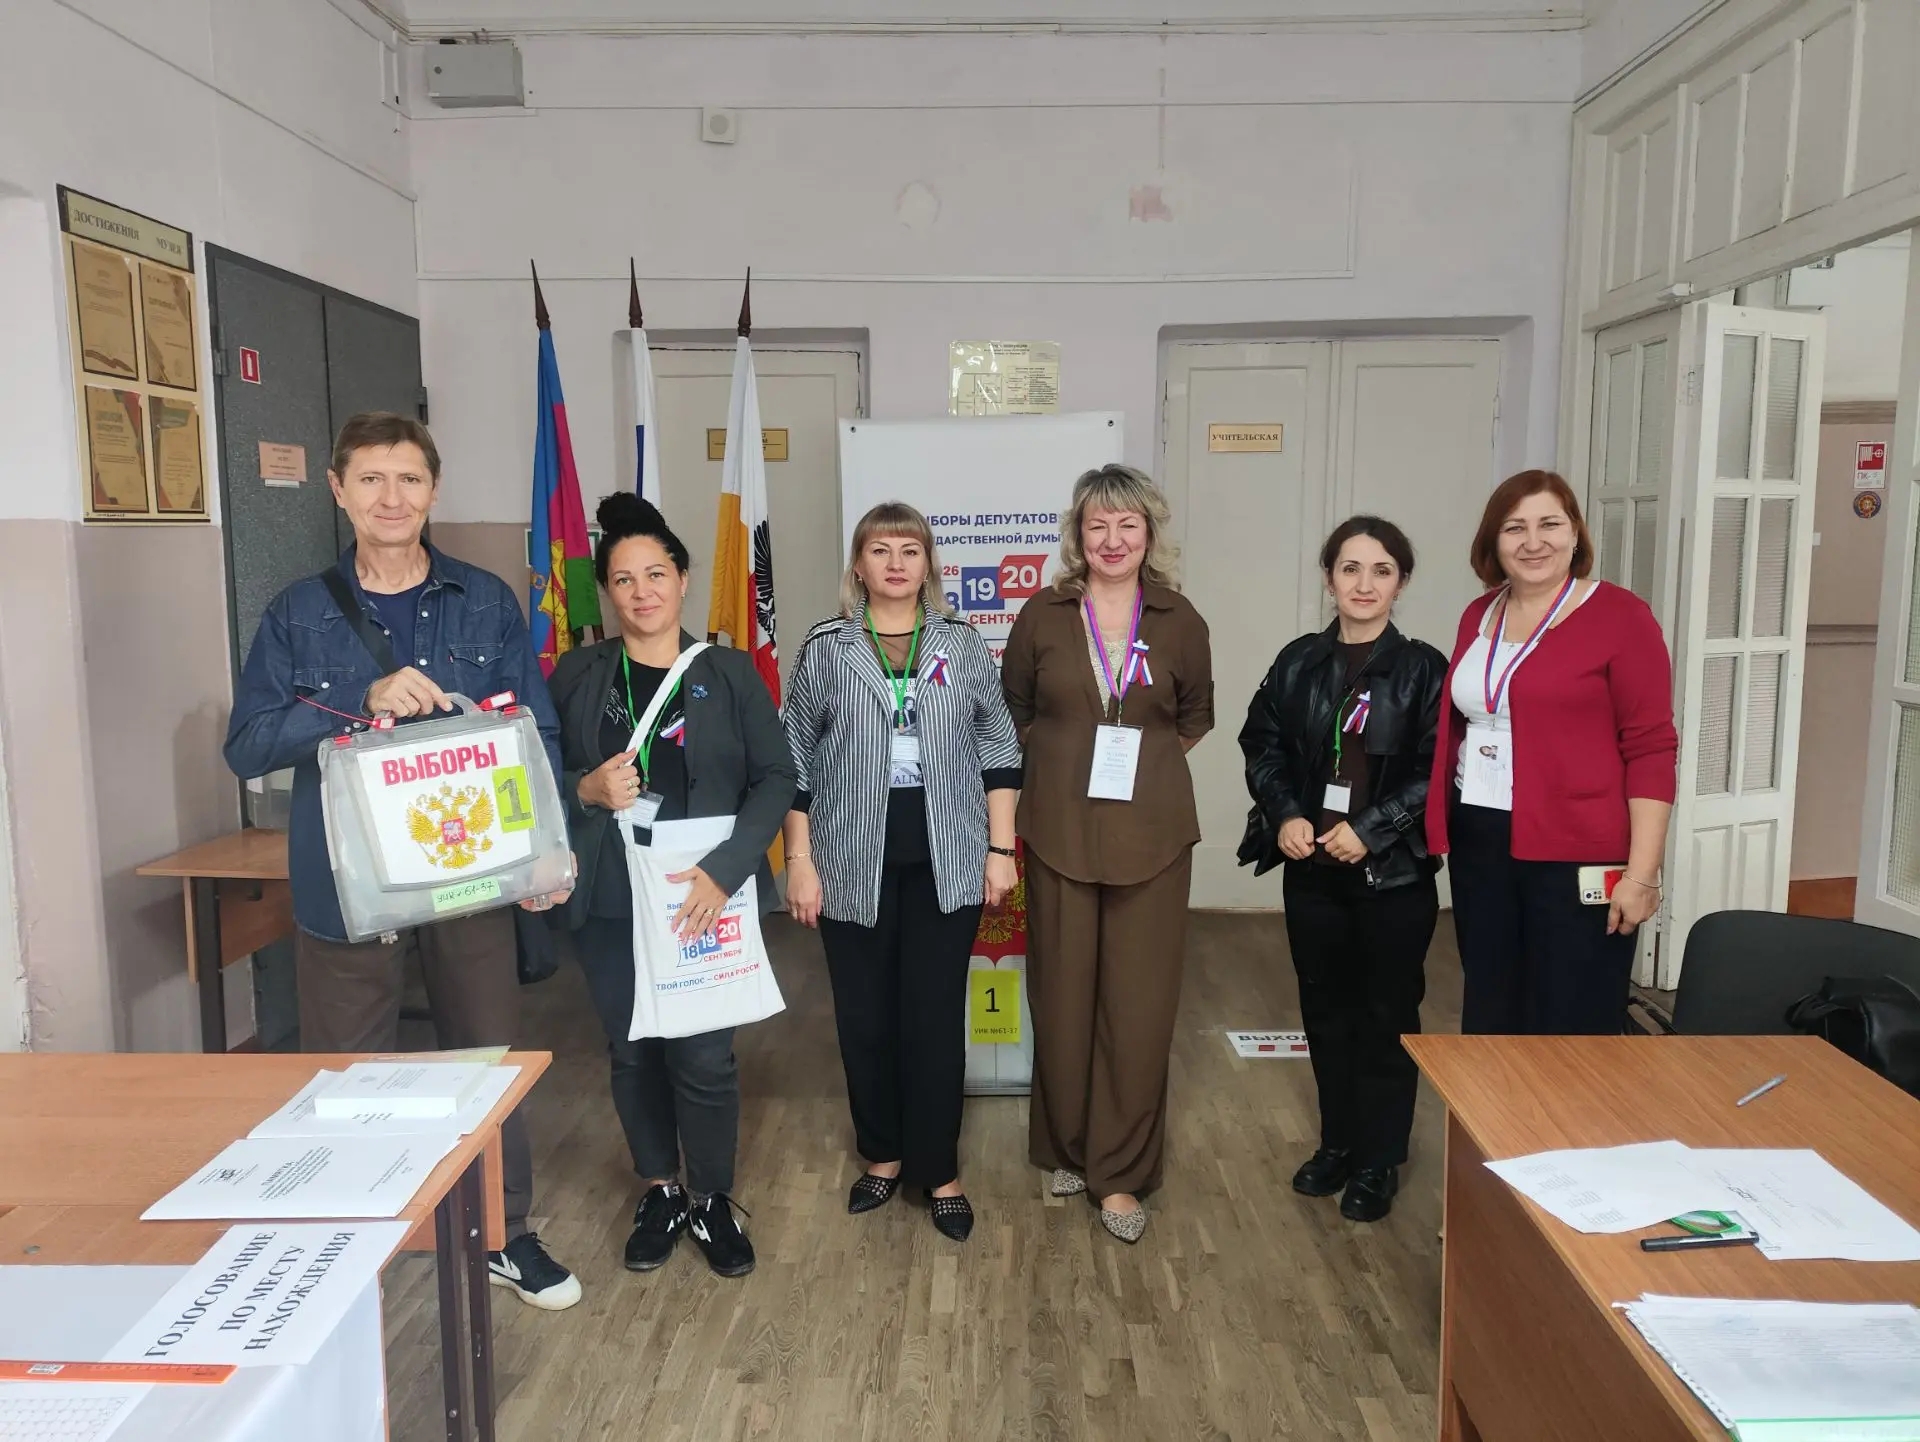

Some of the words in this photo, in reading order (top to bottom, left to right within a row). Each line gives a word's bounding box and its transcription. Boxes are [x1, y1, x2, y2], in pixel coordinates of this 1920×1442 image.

[73, 209, 140, 240] ДОСТИЖЕНИЯ
[1212, 433, 1279, 441] УЧИТЕЛЬСКАЯ
[974, 513, 1058, 527] ДЕПУТАТОВ
[935, 532, 1022, 546] ДАРСТВЕННОЙ
[1025, 534, 1061, 544] ДУМЫ
[943, 565, 960, 576] 26
[1002, 565, 1038, 589] 20
[966, 577, 996, 601] 19
[945, 591, 960, 614] 8
[970, 614, 1019, 625] СЕНТЯ
[381, 742, 498, 787] ВЫБОРЫ
[498, 778, 531, 824] 1
[701, 933, 716, 949] 19
[718, 922, 738, 938] 20
[682, 945, 698, 960] 18
[656, 980, 678, 991] ТВОЙ
[680, 977, 705, 988] ГОЛОС
[736, 963, 760, 975] РОССИ
[985, 988, 1000, 1012] 1
[144, 1231, 277, 1357] ГОЛОСОВАНИЕ
[217, 1305, 257, 1332] ПО
[244, 1245, 305, 1301] МЕСТУ
[242, 1231, 356, 1351] НАХОЖДЕНИЯ
